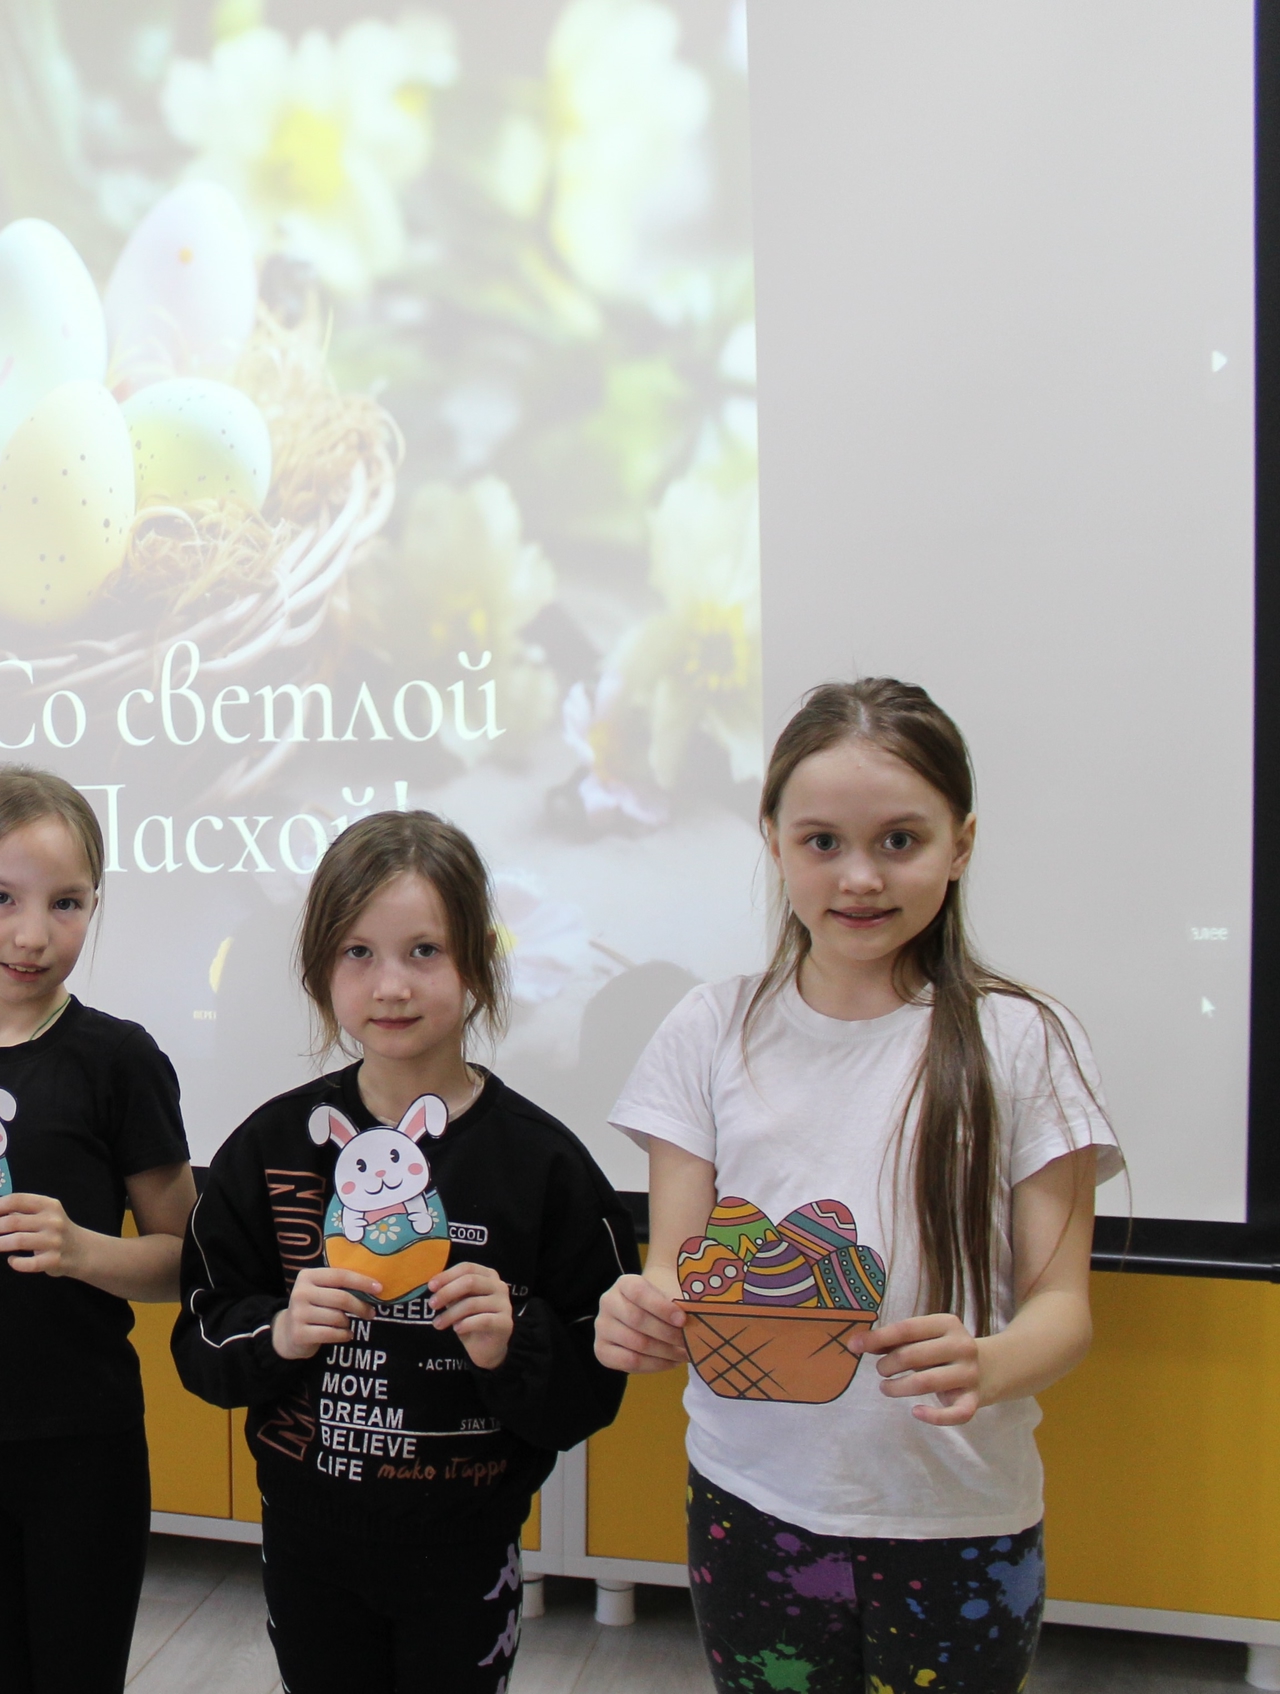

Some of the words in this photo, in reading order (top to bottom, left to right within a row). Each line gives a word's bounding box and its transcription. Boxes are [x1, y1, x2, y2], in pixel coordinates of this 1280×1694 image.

[116, 640, 506, 746] светлой
[449, 1226, 483, 1241] COOL
[326, 1345, 387, 1372] JUMP
[321, 1371, 388, 1400] MOVE
[319, 1398, 404, 1429] DREAM
[460, 1418, 485, 1431] STAY
[320, 1425, 417, 1459] BELIEVE
[317, 1451, 364, 1481] LIFE
